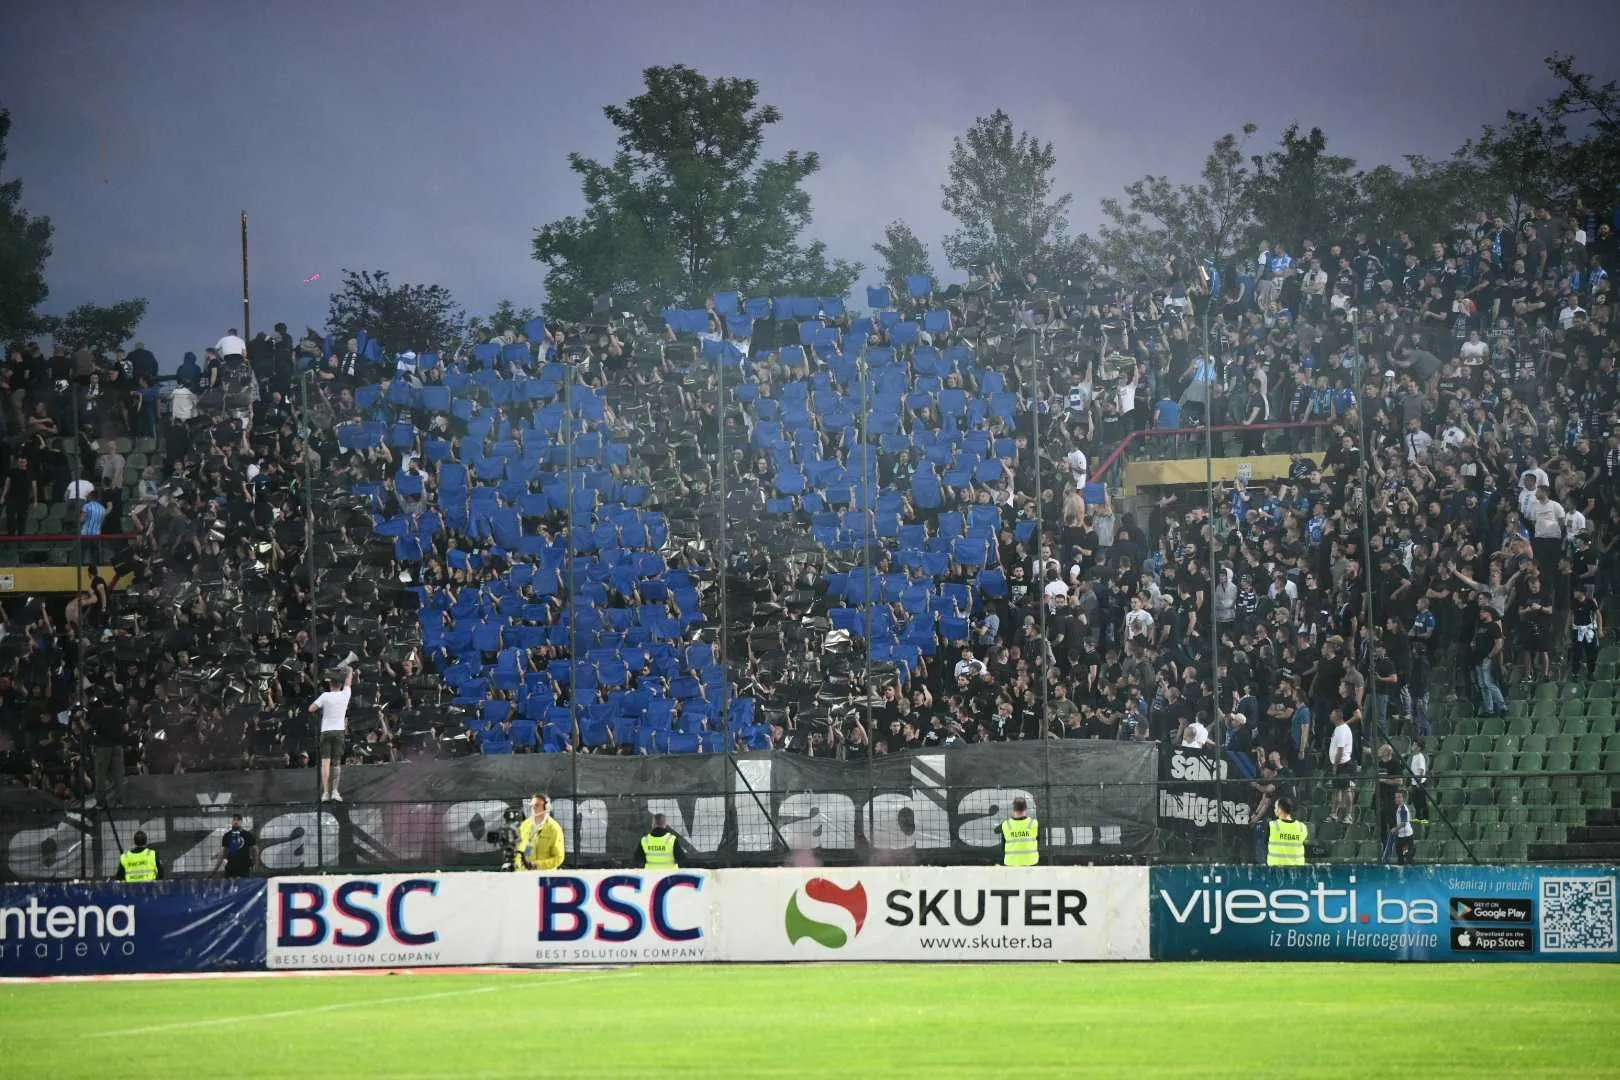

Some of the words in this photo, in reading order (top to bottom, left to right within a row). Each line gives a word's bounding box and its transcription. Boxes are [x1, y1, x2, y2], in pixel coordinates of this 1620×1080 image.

[277, 878, 440, 948] BSC
[538, 874, 705, 942] BSC
[885, 889, 1088, 927] SKUTER
[1160, 875, 1438, 934] vijesti.ba
[1474, 908, 1506, 919] Google
[1508, 908, 1526, 919] Play
[0, 897, 136, 940] ntena
[920, 935, 1053, 949] www.skuter.ba
[1270, 931, 1281, 946] iz
[1287, 930, 1331, 947] Bosne
[1336, 930, 1340, 946] i
[1345, 930, 1438, 950] Hercegovine
[1476, 938, 1497, 948] App
[1498, 938, 1525, 947] Store
[0, 941, 136, 961] rajevo
[275, 955, 307, 965] BEST
[312, 953, 375, 964] SOLUTION
[380, 951, 441, 962] COMPANY
[536, 949, 569, 960] BEST
[574, 949, 637, 959] SOLUTION
[643, 948, 705, 958] COMPANY
